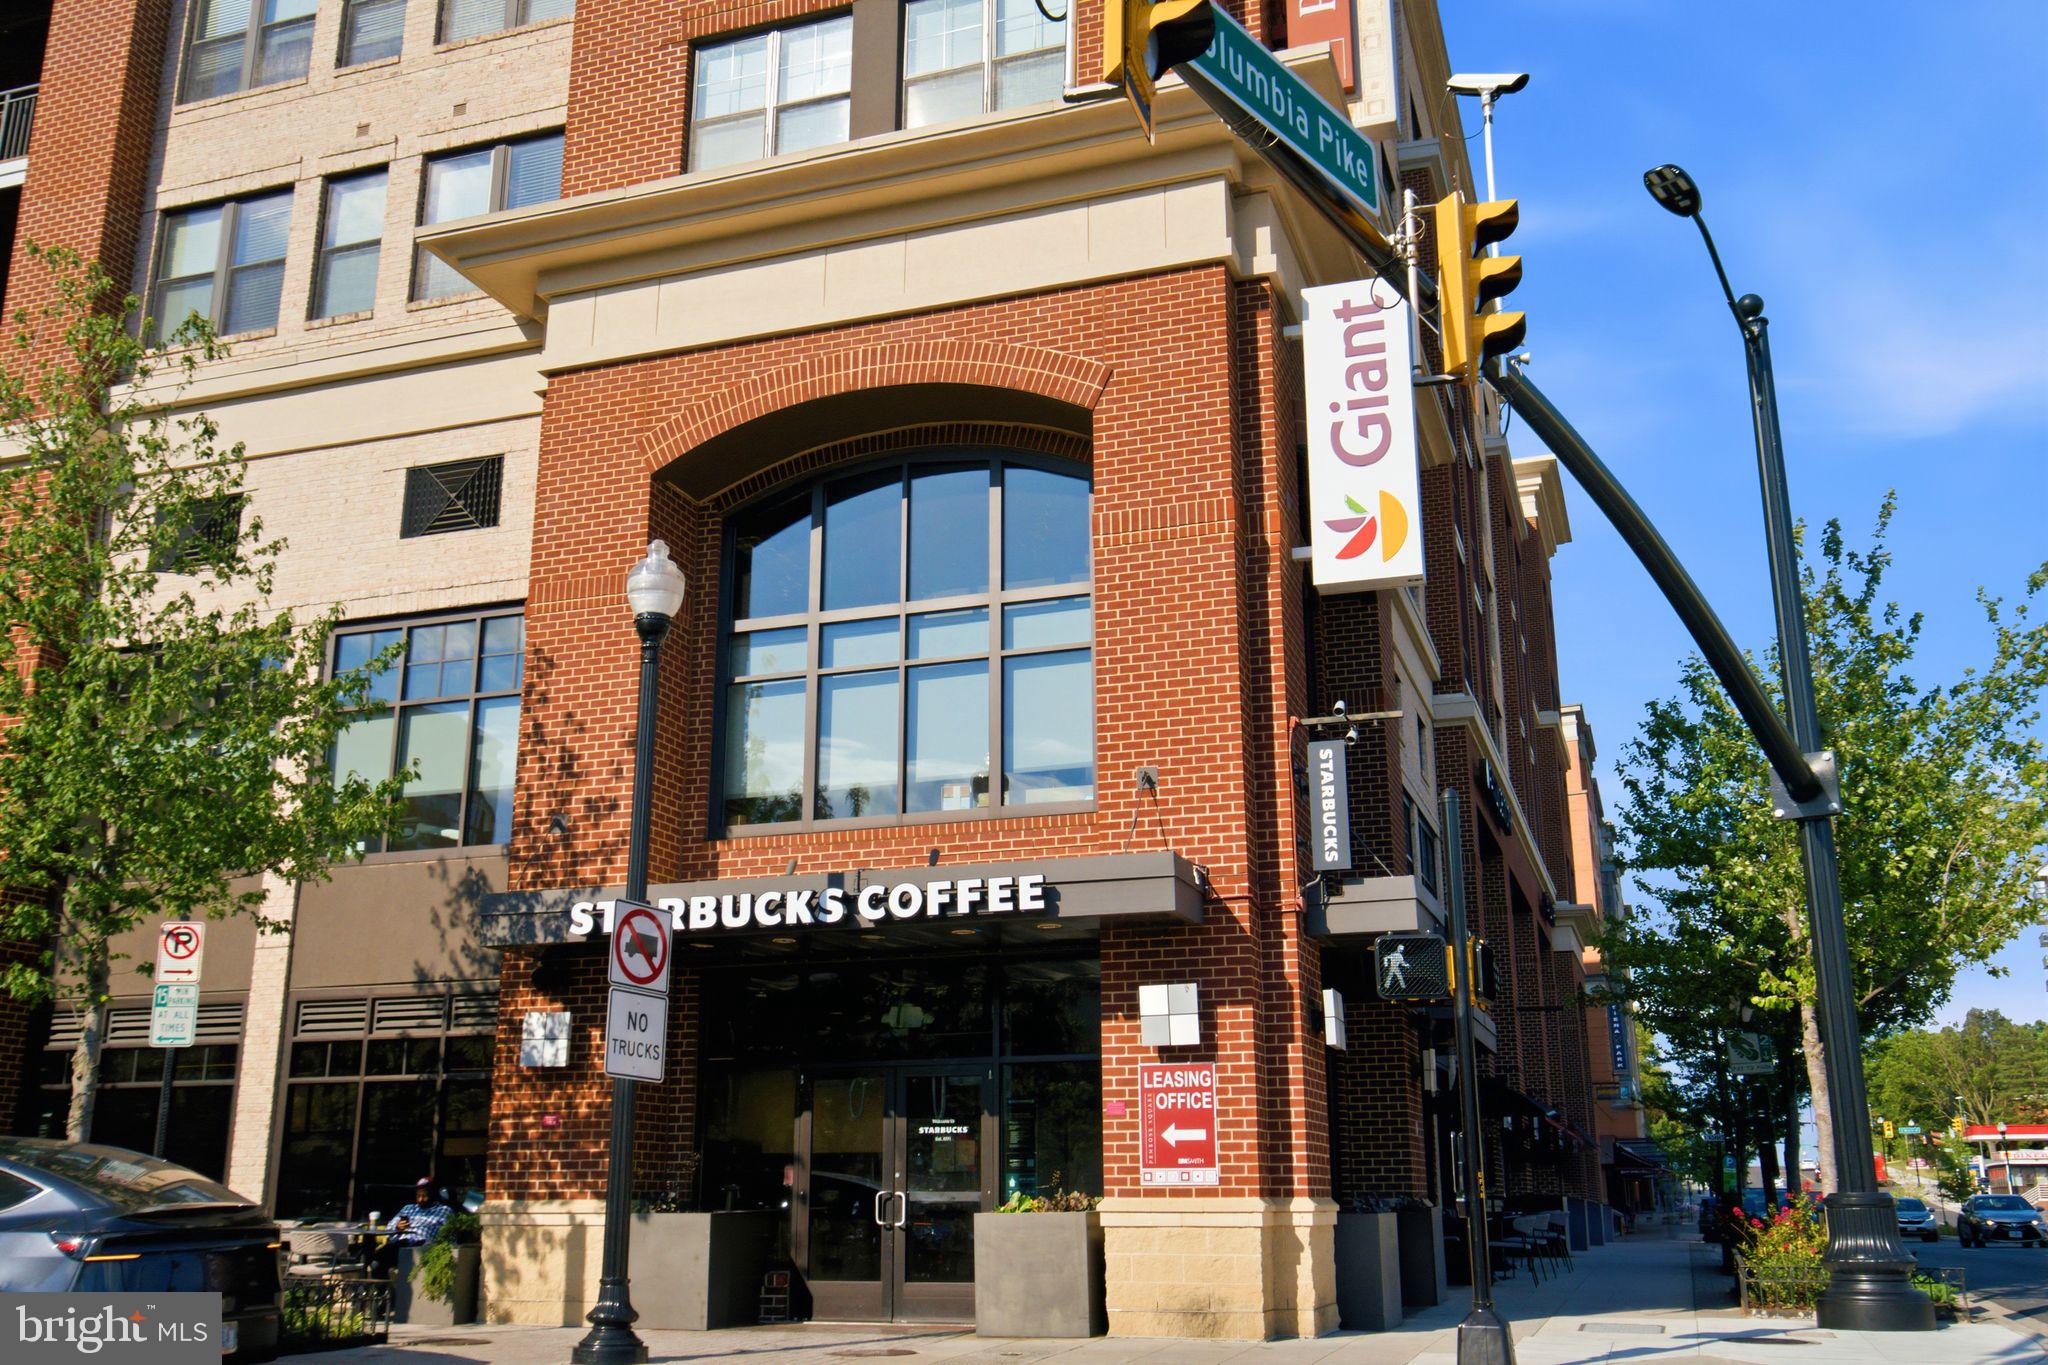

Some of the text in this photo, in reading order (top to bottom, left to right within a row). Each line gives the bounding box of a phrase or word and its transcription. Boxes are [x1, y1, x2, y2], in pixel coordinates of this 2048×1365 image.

[1318, 115, 1368, 188] Pike
[1329, 294, 1392, 467] Giant
[1319, 748, 1338, 863] STARBUCKS
[569, 874, 1046, 936] STRBUCKS COFFEE
[158, 1010, 189, 1019] AT ALL
[627, 1011, 648, 1032] NO
[160, 1023, 186, 1033] TIMES
[612, 1038, 660, 1061] TRUCKS
[1143, 1070, 1212, 1088] LEASING
[1155, 1091, 1213, 1109] OFFICE
[918, 1126, 969, 1134] STARBUCKS
